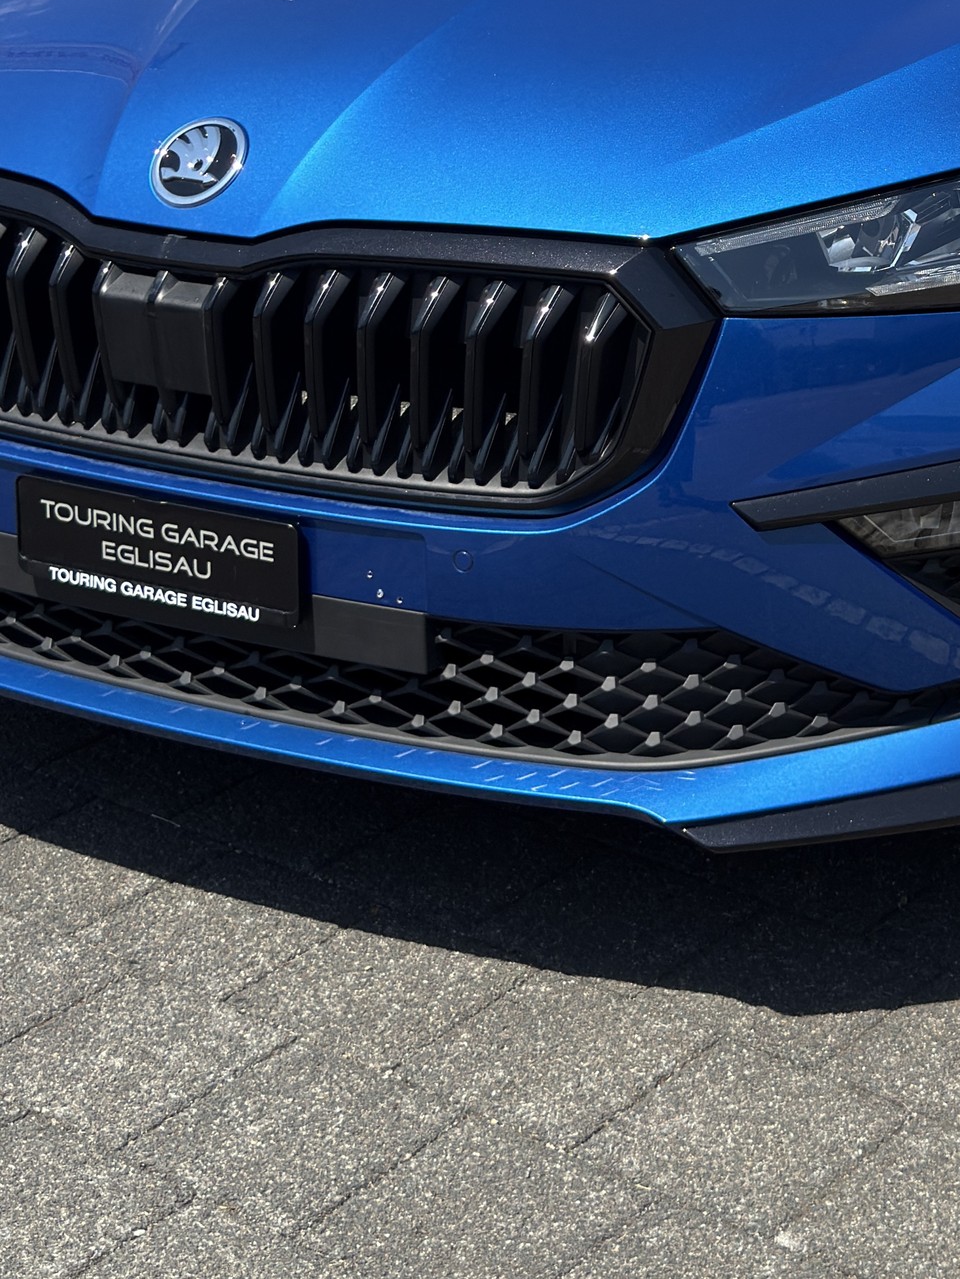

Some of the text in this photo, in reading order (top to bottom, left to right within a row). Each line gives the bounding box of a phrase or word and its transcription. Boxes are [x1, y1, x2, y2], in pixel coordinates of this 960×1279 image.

[40, 499, 274, 562] TOURING GARAGE
[102, 540, 212, 579] EGLISAU
[49, 566, 260, 622] TOURING GARAGE EGLISAU
